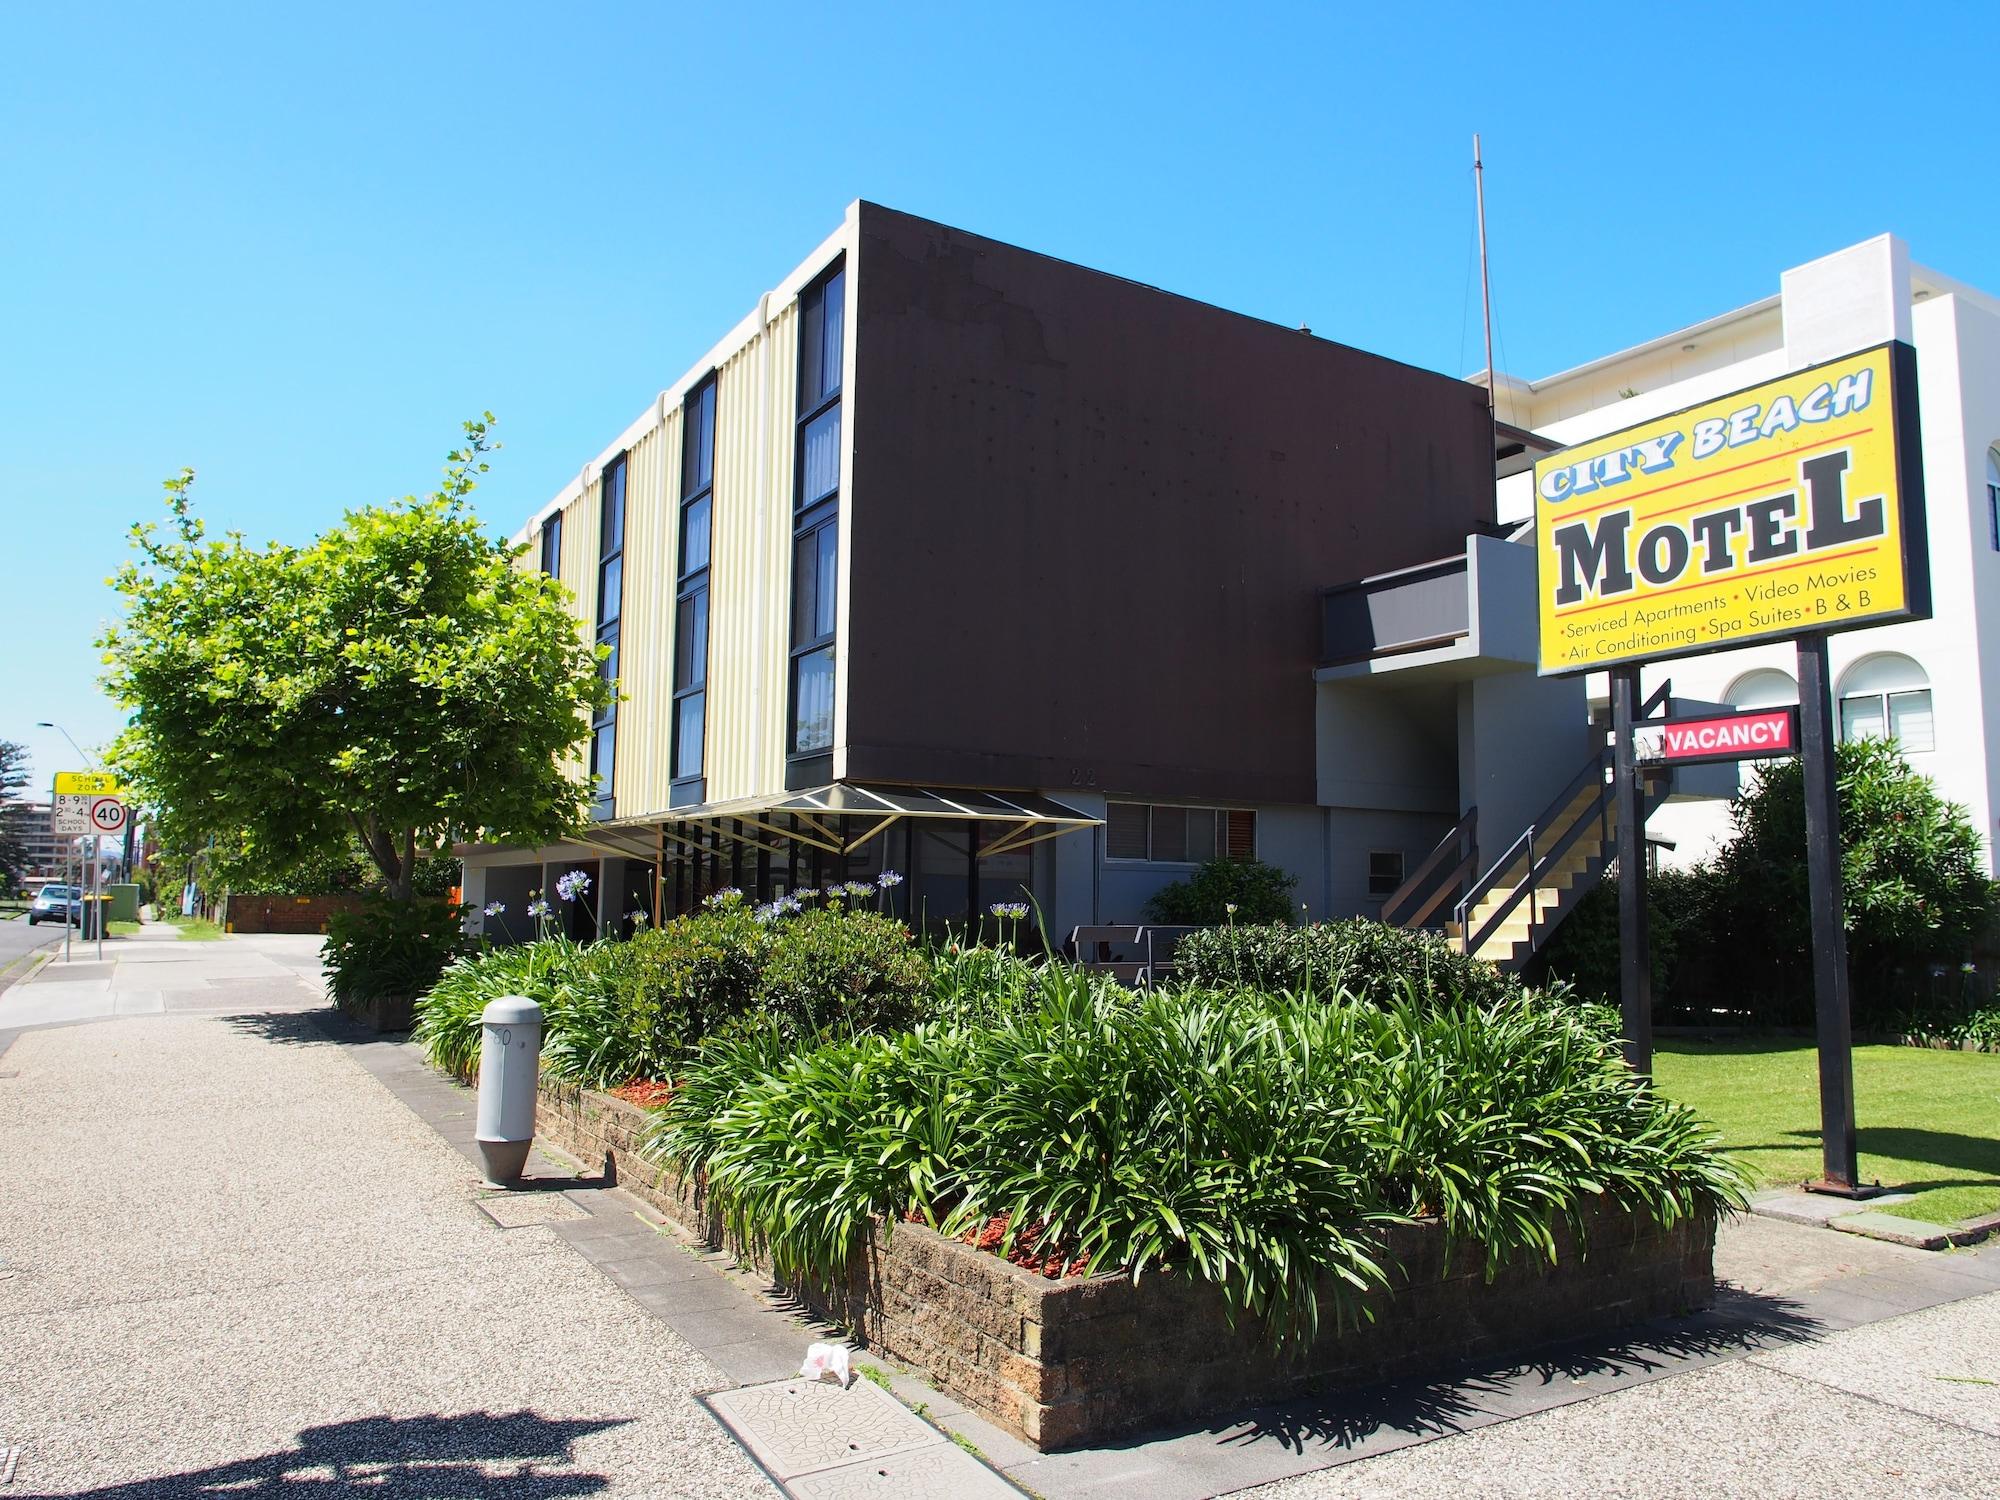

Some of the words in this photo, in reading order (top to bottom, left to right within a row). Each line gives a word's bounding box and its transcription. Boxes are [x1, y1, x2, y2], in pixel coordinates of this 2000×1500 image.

[1540, 431, 1684, 502] CITY
[1692, 369, 1873, 459] BEACH
[1554, 450, 1885, 606] MOTEL
[1567, 611, 1628, 638] Serviced
[1634, 596, 1727, 627] Apartments
[1745, 580, 1799, 602] Video
[1807, 566, 1877, 591] Movies
[1569, 644, 1590, 660] Air
[1596, 627, 1696, 655] Conditioning
[1709, 618, 1742, 637] Spa
[1750, 608, 1801, 627] Suites
[1816, 598, 1827, 615] B
[1836, 594, 1851, 612] &
[1859, 590, 1871, 607] B
[1668, 720, 1785, 752] VACANCY
[97, 808, 120, 821] 40
